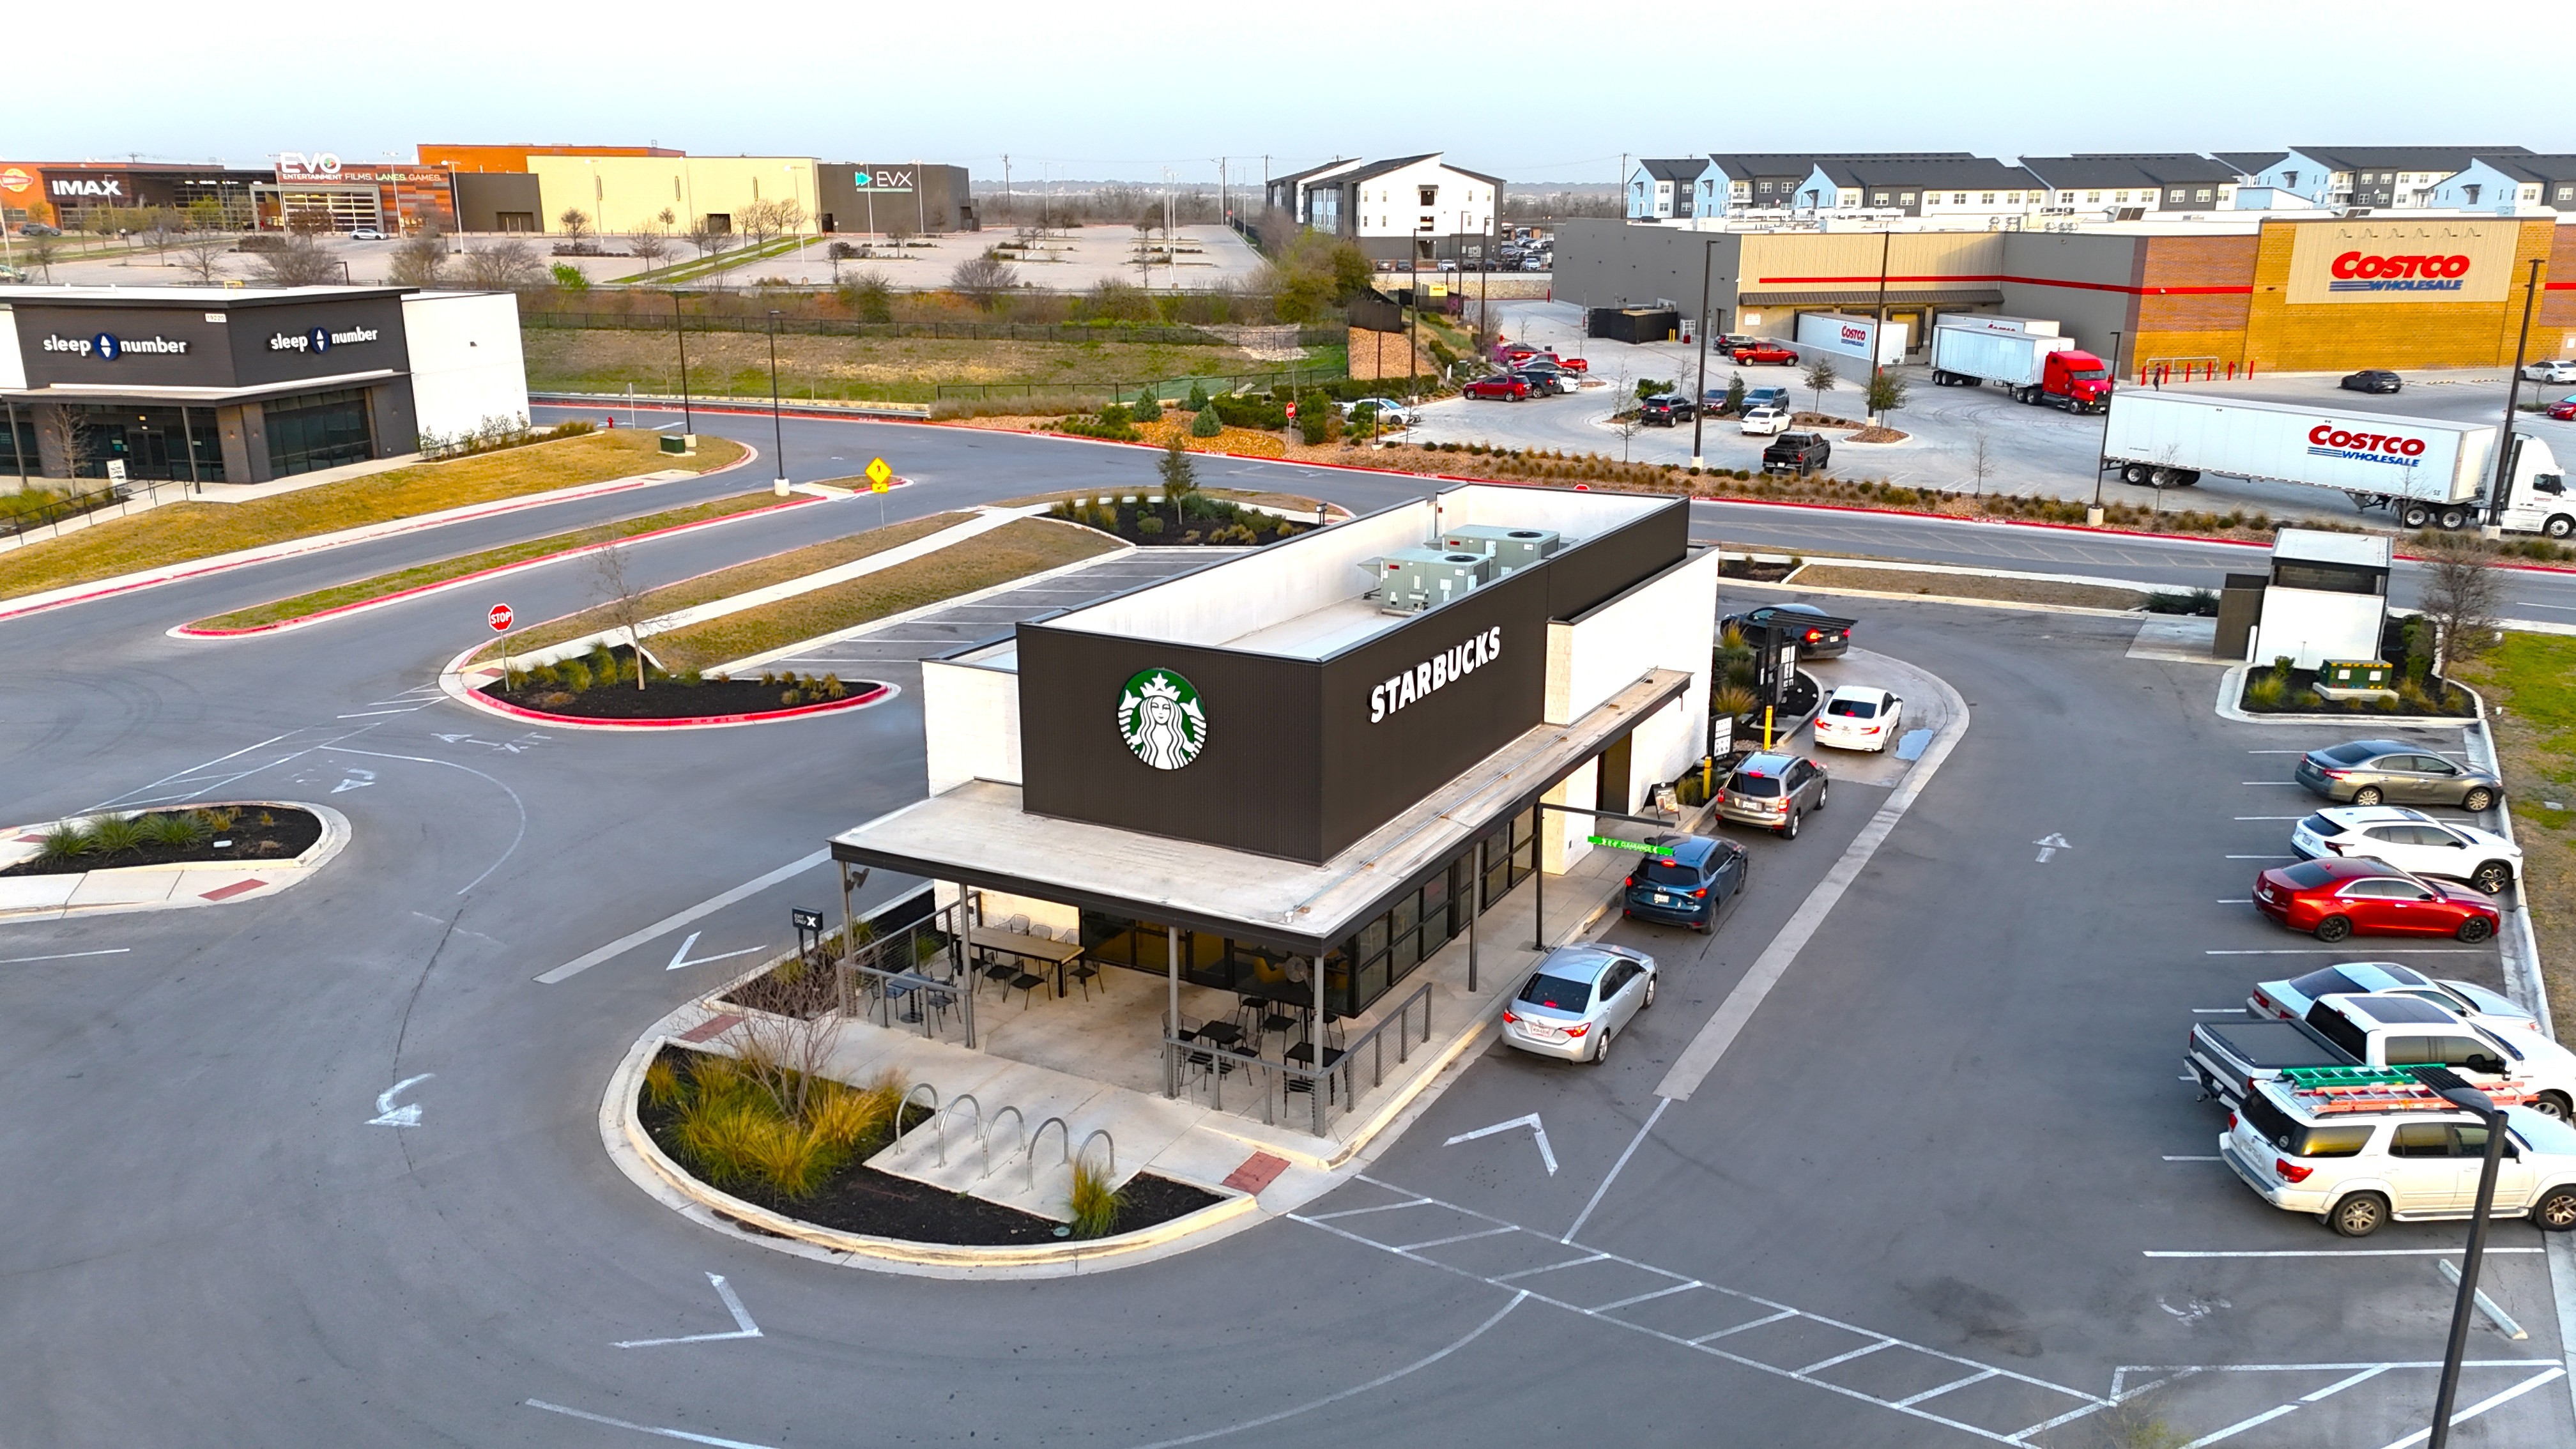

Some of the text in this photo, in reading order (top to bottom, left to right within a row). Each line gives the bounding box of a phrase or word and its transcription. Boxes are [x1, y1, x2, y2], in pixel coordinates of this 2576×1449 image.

[279, 152, 341, 174] EVO
[52, 180, 122, 195] IMAX
[876, 171, 913, 187] EVX
[2331, 251, 2470, 279] COSTCO
[2370, 280, 2464, 291] WHOLESALE
[271, 326, 378, 352] sleep number
[1841, 325, 1866, 341] COSTCO
[43, 334, 187, 357] sleep number
[2308, 425, 2426, 457] COSTCO
[2342, 450, 2421, 468] WHOLESALE
[491, 611, 511, 624] STOP
[1370, 625, 1501, 724] STARBUCKS
[1620, 841, 1652, 853] CLEARANCE
